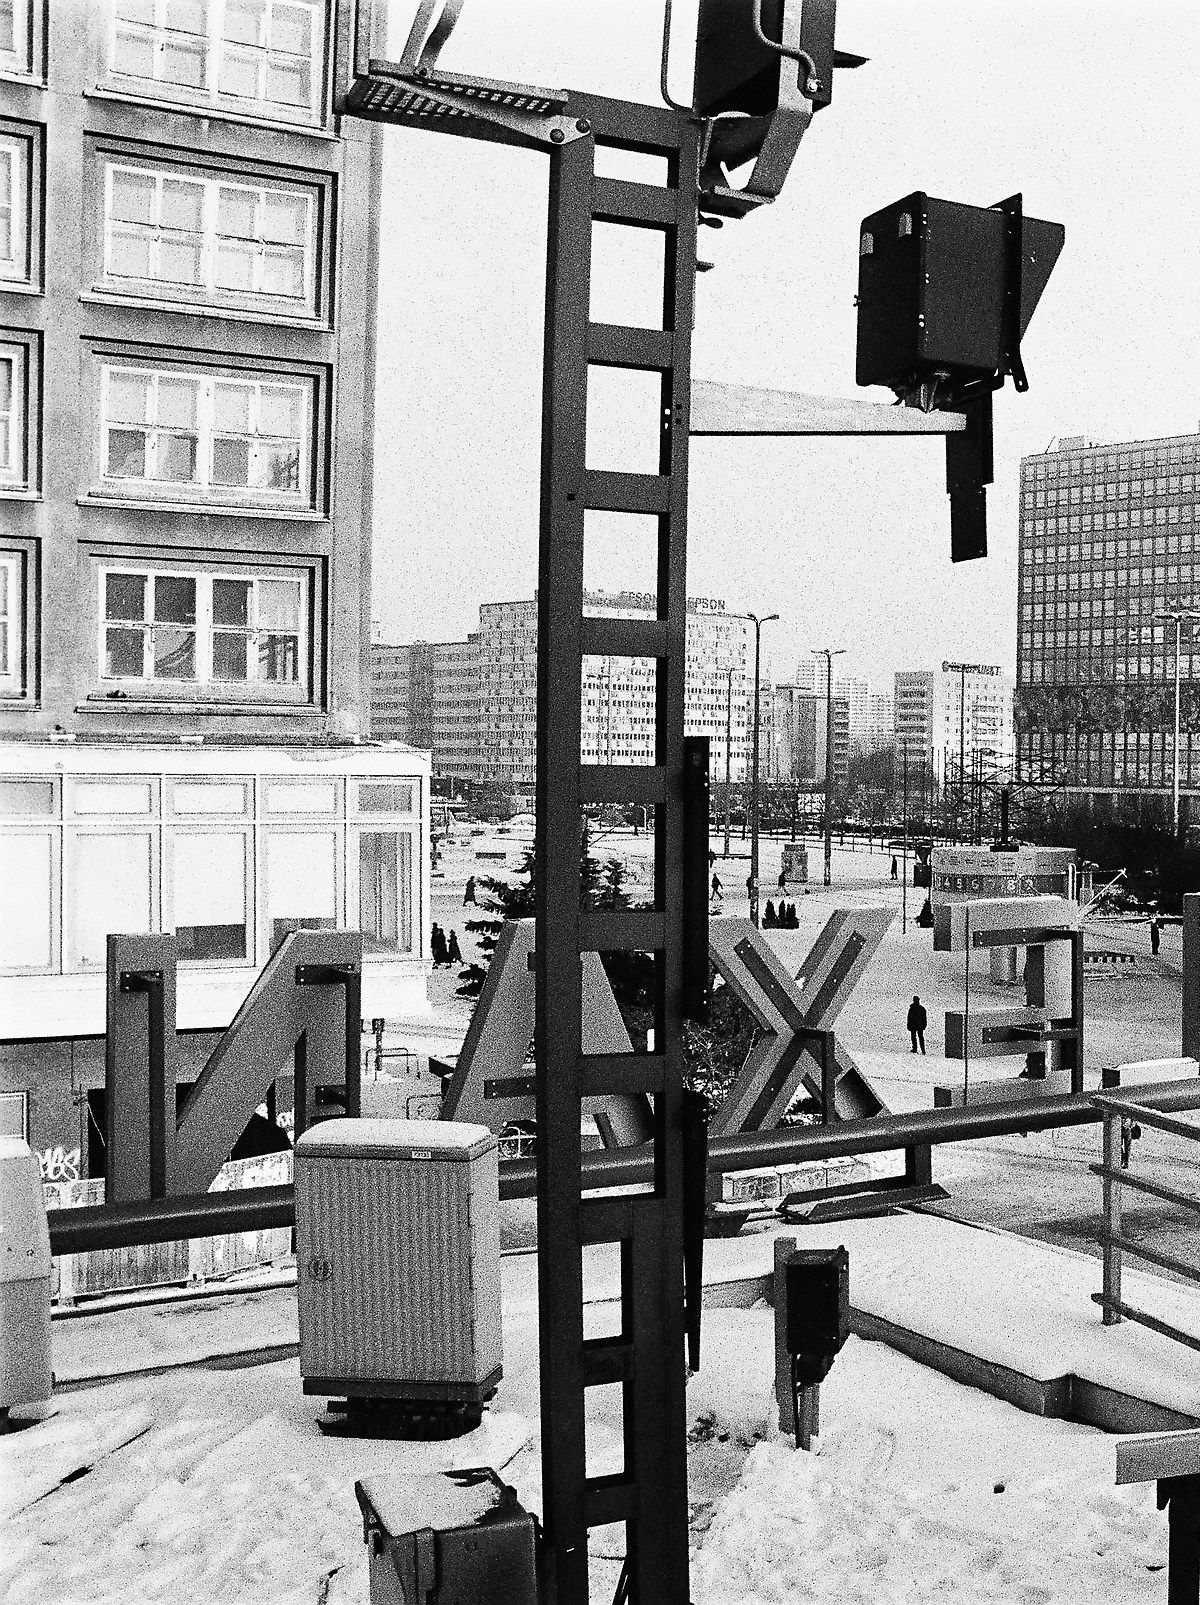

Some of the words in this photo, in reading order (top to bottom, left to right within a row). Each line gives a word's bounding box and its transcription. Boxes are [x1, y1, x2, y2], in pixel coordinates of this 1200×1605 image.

[687, 597, 725, 610] EPSON
[956, 878, 963, 889] 5
[971, 879, 979, 889] 6
[1007, 880, 1016, 890] 8
